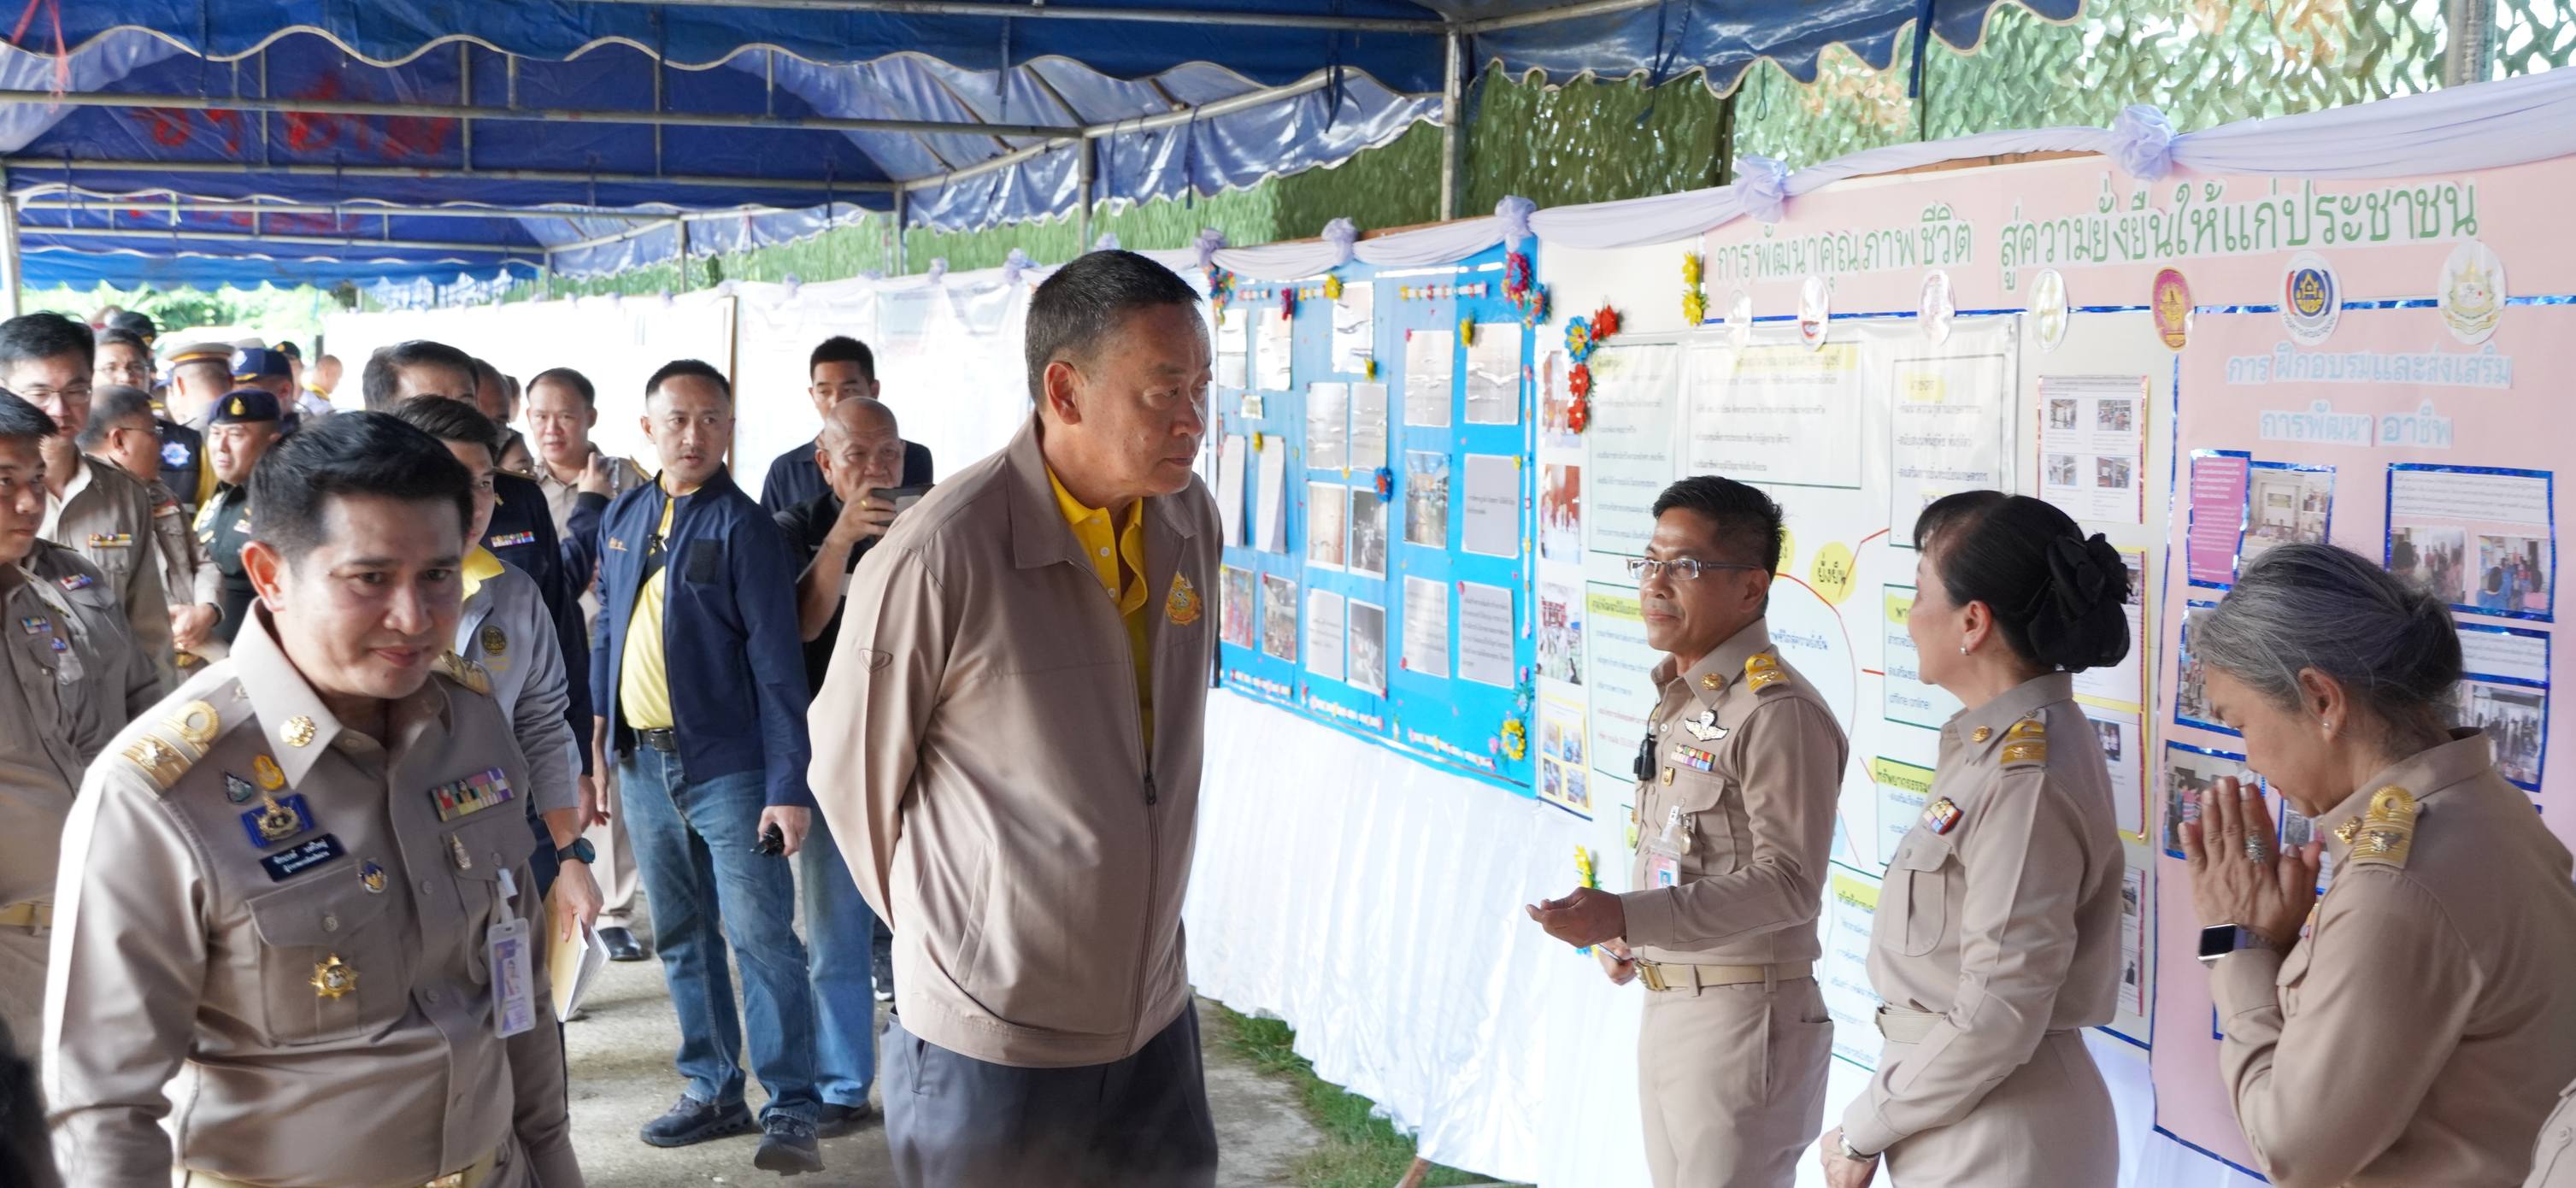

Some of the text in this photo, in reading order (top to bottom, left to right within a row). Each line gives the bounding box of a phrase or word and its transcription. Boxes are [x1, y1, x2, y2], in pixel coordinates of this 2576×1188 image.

[1717, 177, 2478, 291] การพัฒนาคุณภาพชีวิต สู่ความยั่งยืนให้แก่ประชาชน
[2228, 343, 2511, 383] การฝึกอบรมและส่งเสริม
[2262, 401, 2452, 444] การพัฒนา อาชีพ
